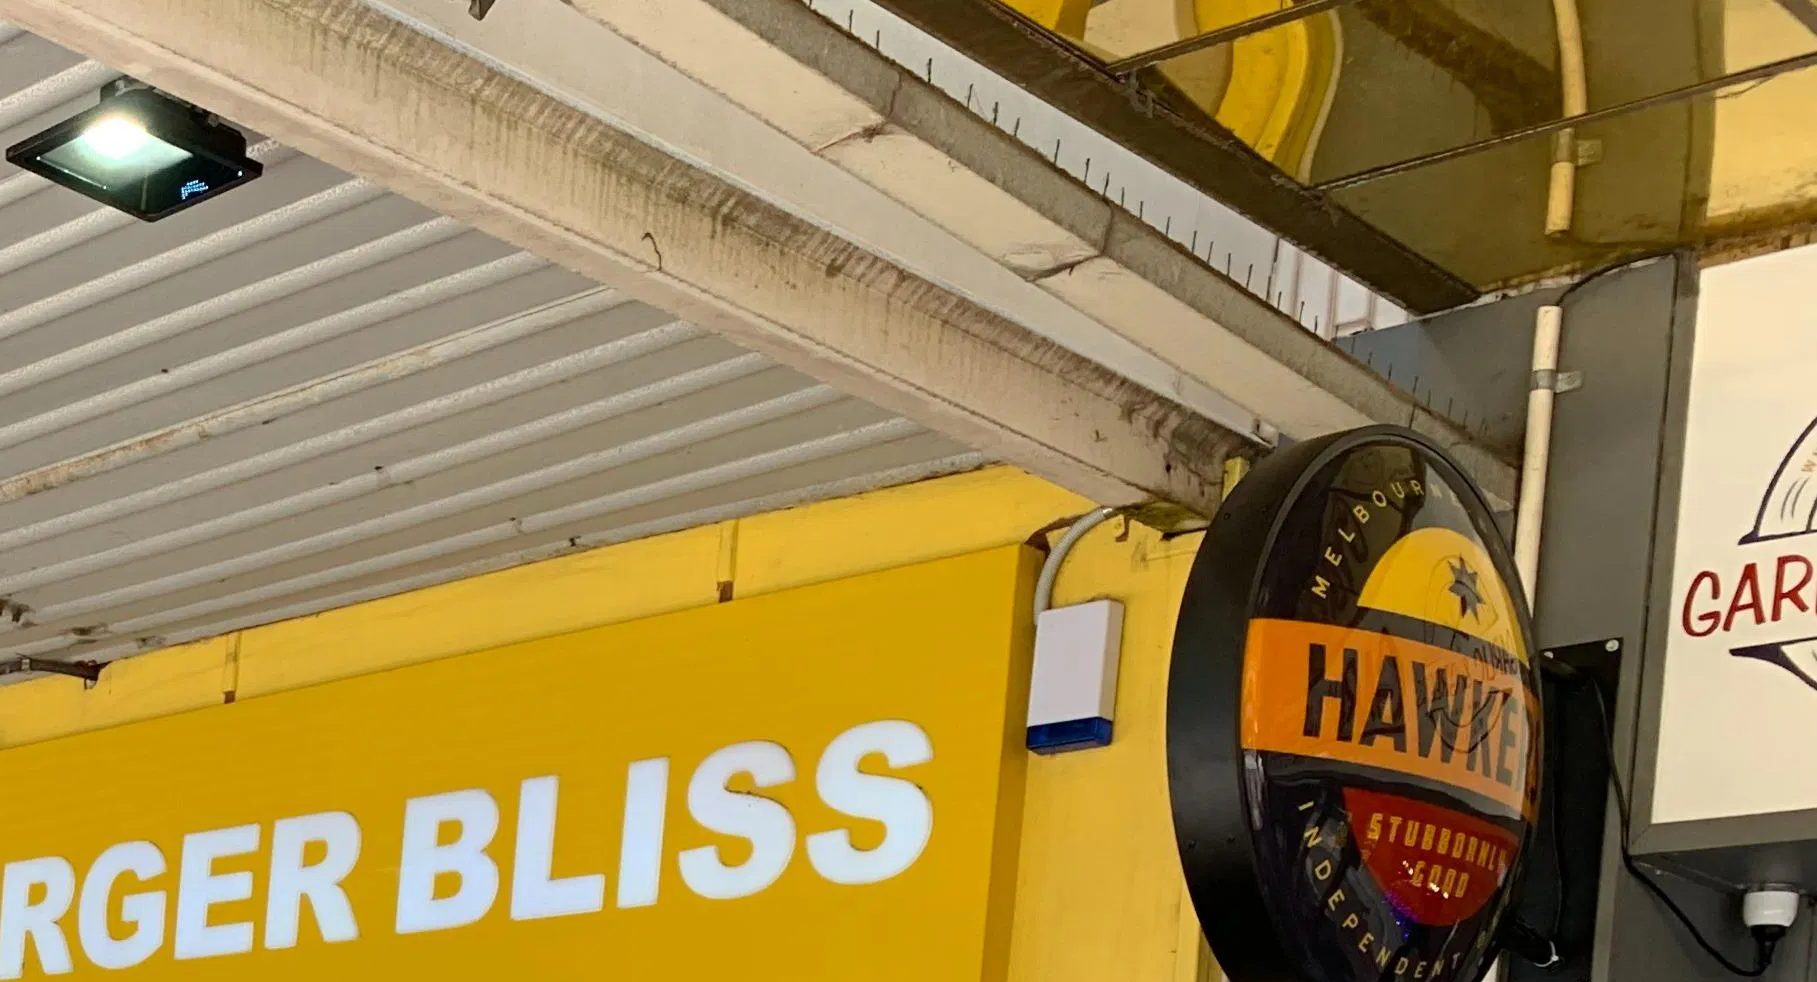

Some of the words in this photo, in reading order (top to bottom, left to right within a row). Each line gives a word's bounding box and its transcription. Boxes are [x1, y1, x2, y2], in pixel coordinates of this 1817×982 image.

[1683, 554, 1817, 637] GAR
[1303, 643, 1528, 792] HAWKE
[395, 719, 935, 935] BLISS
[1298, 800, 1461, 981] INDEPENDENT
